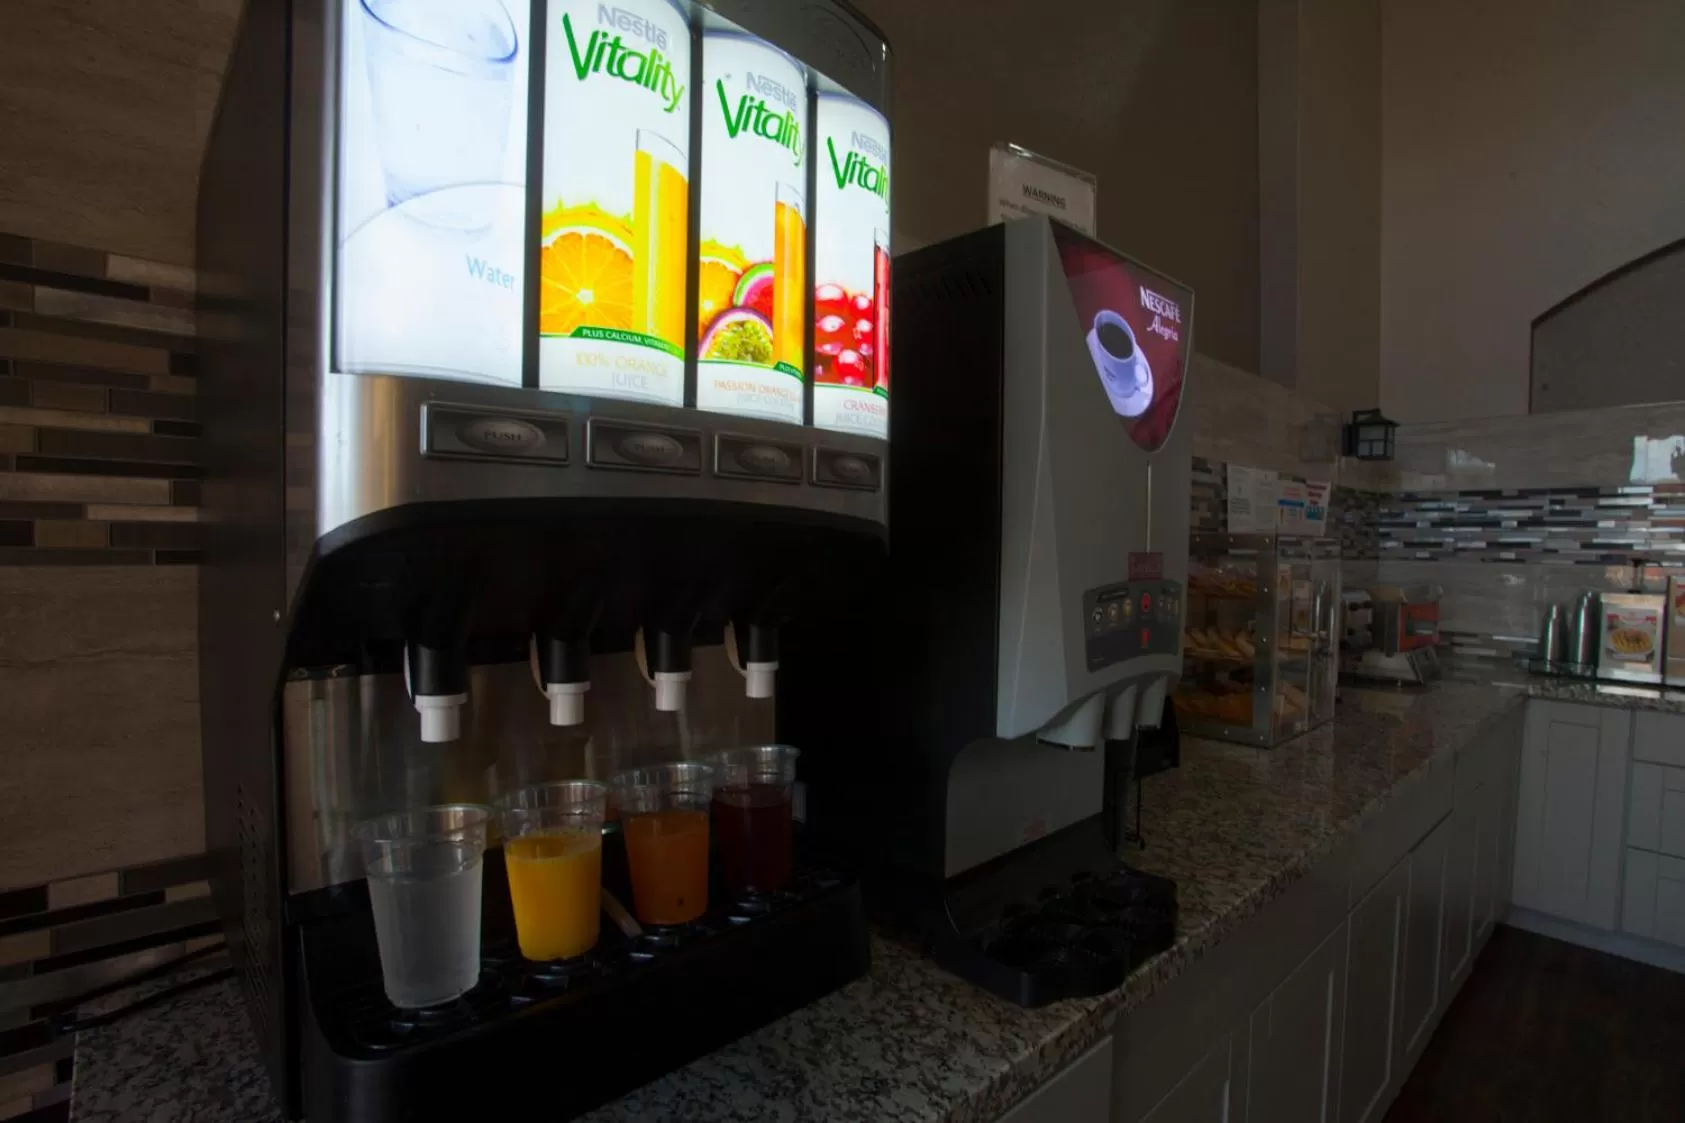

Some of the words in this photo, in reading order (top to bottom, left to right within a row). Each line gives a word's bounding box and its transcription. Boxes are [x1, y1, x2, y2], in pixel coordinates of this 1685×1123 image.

[562, 12, 685, 113] Vitality
[716, 77, 805, 167] Vitality
[1022, 183, 1067, 209] WARNING
[465, 253, 516, 292] Water
[582, 328, 604, 338] PLUS
[605, 330, 642, 343] CALCIUM
[614, 355, 669, 378] ORANGE
[612, 372, 650, 391] JUICE
[484, 431, 521, 441] PUSH
